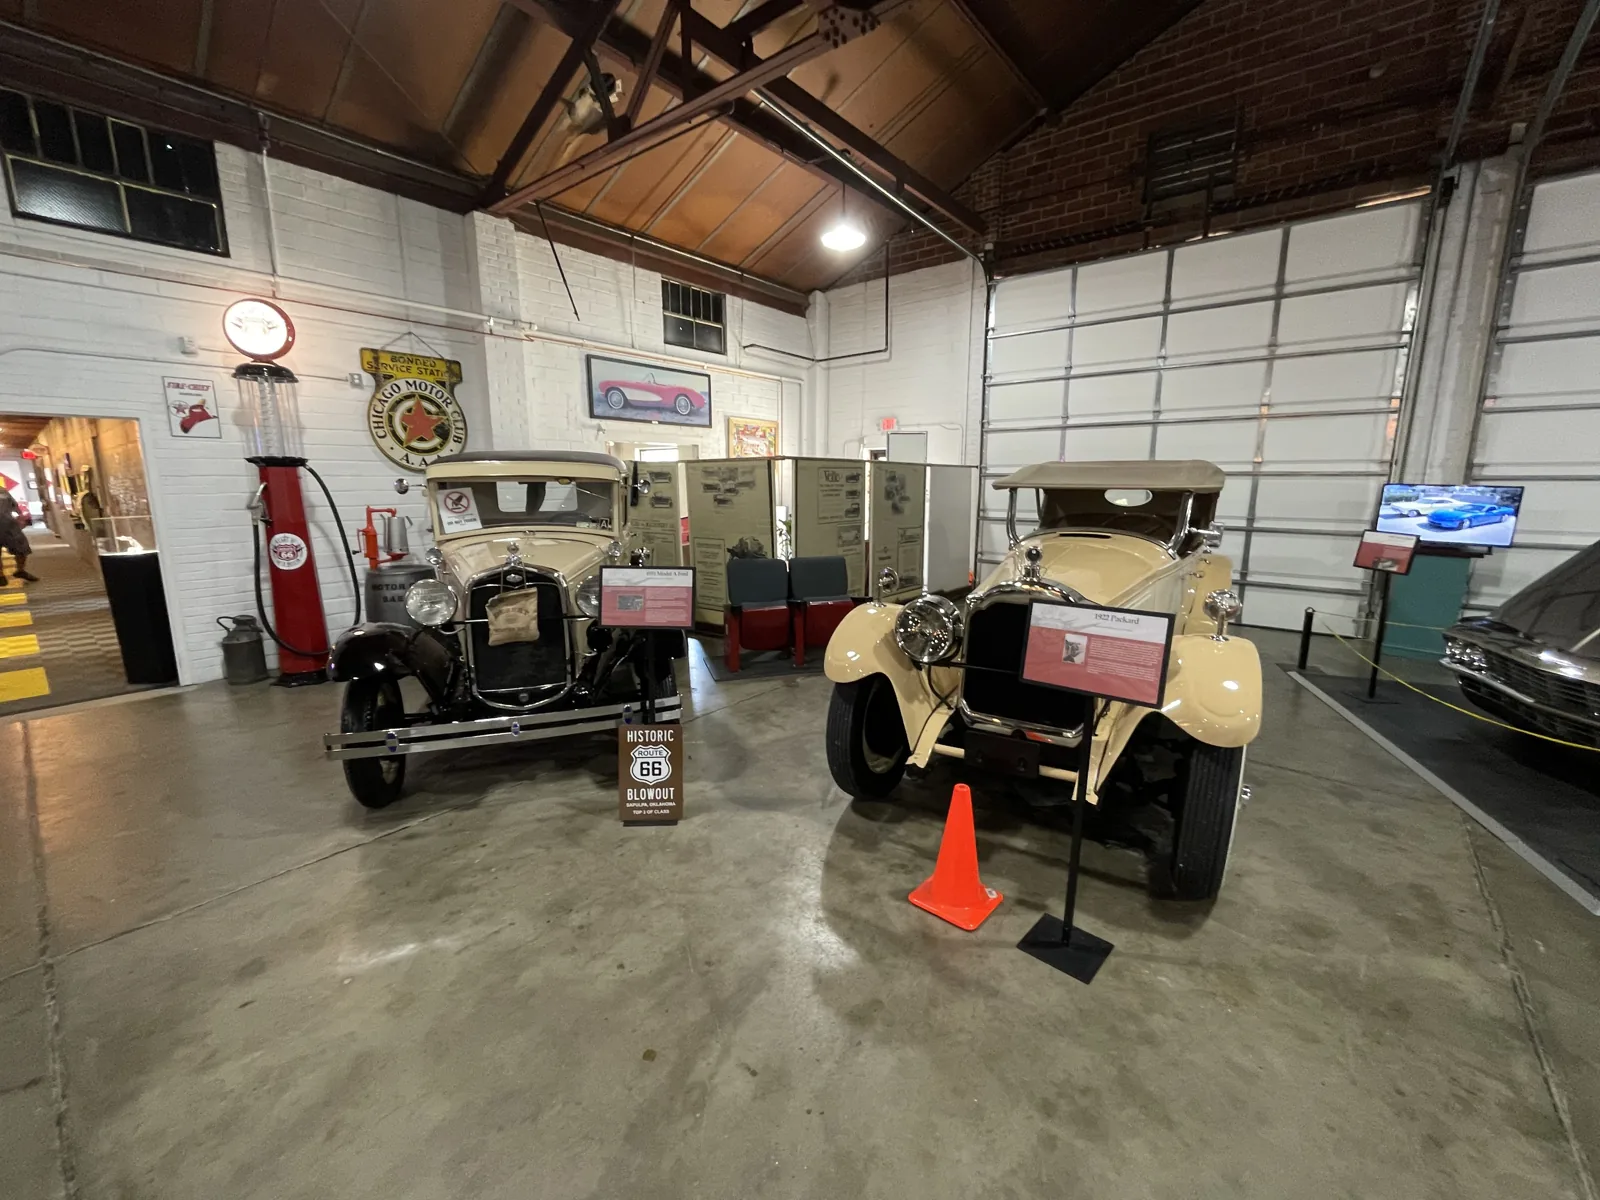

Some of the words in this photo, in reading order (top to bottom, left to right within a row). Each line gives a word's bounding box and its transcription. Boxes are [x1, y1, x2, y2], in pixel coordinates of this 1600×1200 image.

[391, 355, 437, 368] BONDED
[366, 361, 412, 374] SERVICE
[417, 367, 452, 380] STATI
[372, 382, 401, 440] CHICAGO
[405, 380, 453, 408] MOTOR
[451, 410, 464, 444] CLUB
[372, 583, 406, 591] MOTOR
[1095, 613, 1110, 621] 1922
[1111, 614, 1139, 625] Packard
[627, 730, 674, 742] HISTORIC
[640, 761, 662, 776] 66
[627, 787, 675, 800] BLOWOUT
